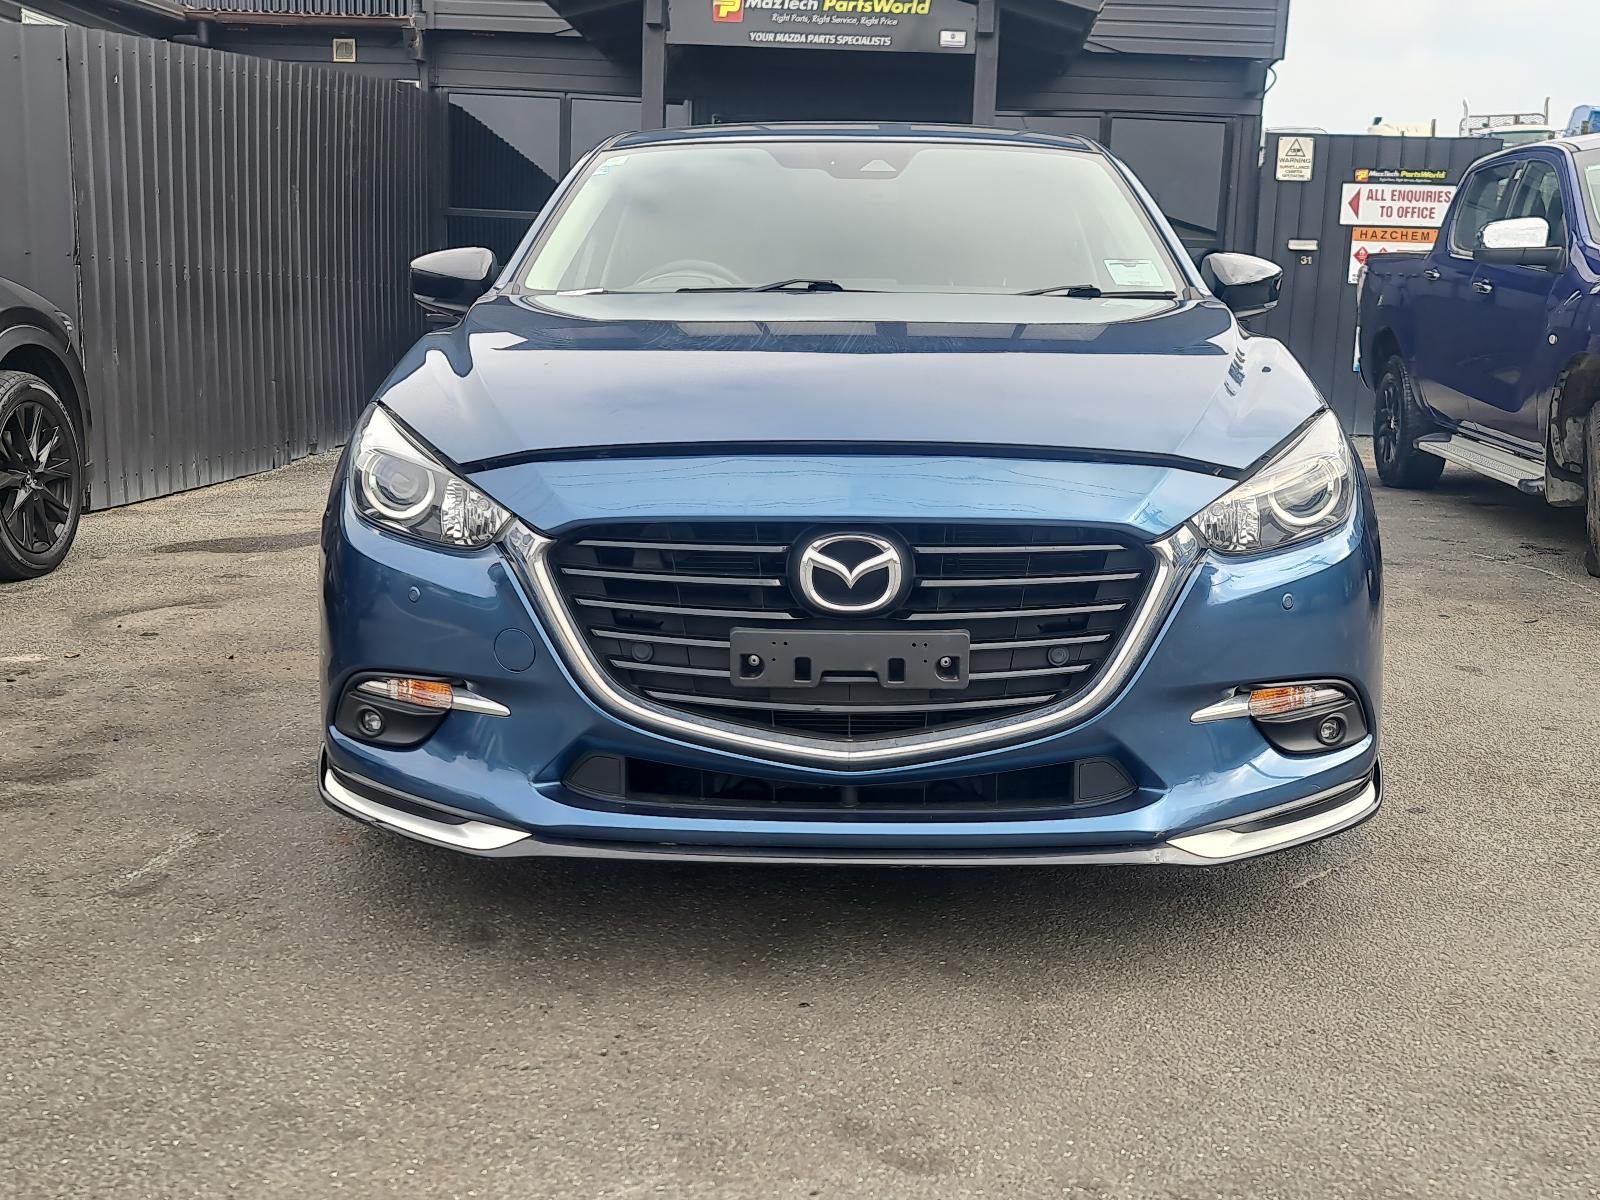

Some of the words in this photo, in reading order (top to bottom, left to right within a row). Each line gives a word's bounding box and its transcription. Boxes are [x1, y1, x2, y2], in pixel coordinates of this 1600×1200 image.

[745, 0, 818, 11] MazTech
[822, 0, 931, 14] PartsWorld
[771, 13, 790, 23] Right
[791, 14, 810, 23] Parts,
[812, 15, 830, 25] Right
[831, 15, 859, 25] Service,
[860, 16, 879, 26] Right
[879, 17, 898, 26] Price
[749, 32, 774, 42] YOUR
[775, 33, 806, 43] MAZDA
[807, 34, 835, 44] PARTS
[836, 34, 892, 46] SPECIALISTS
[1366, 189, 1387, 201] ALL
[1391, 189, 1452, 203] ENQUIRIES
[1380, 206, 1393, 218] TO
[1397, 206, 1436, 219] OFFICE
[1360, 230, 1430, 241] HAZCHEM
[1300, 255, 1312, 265] 31
